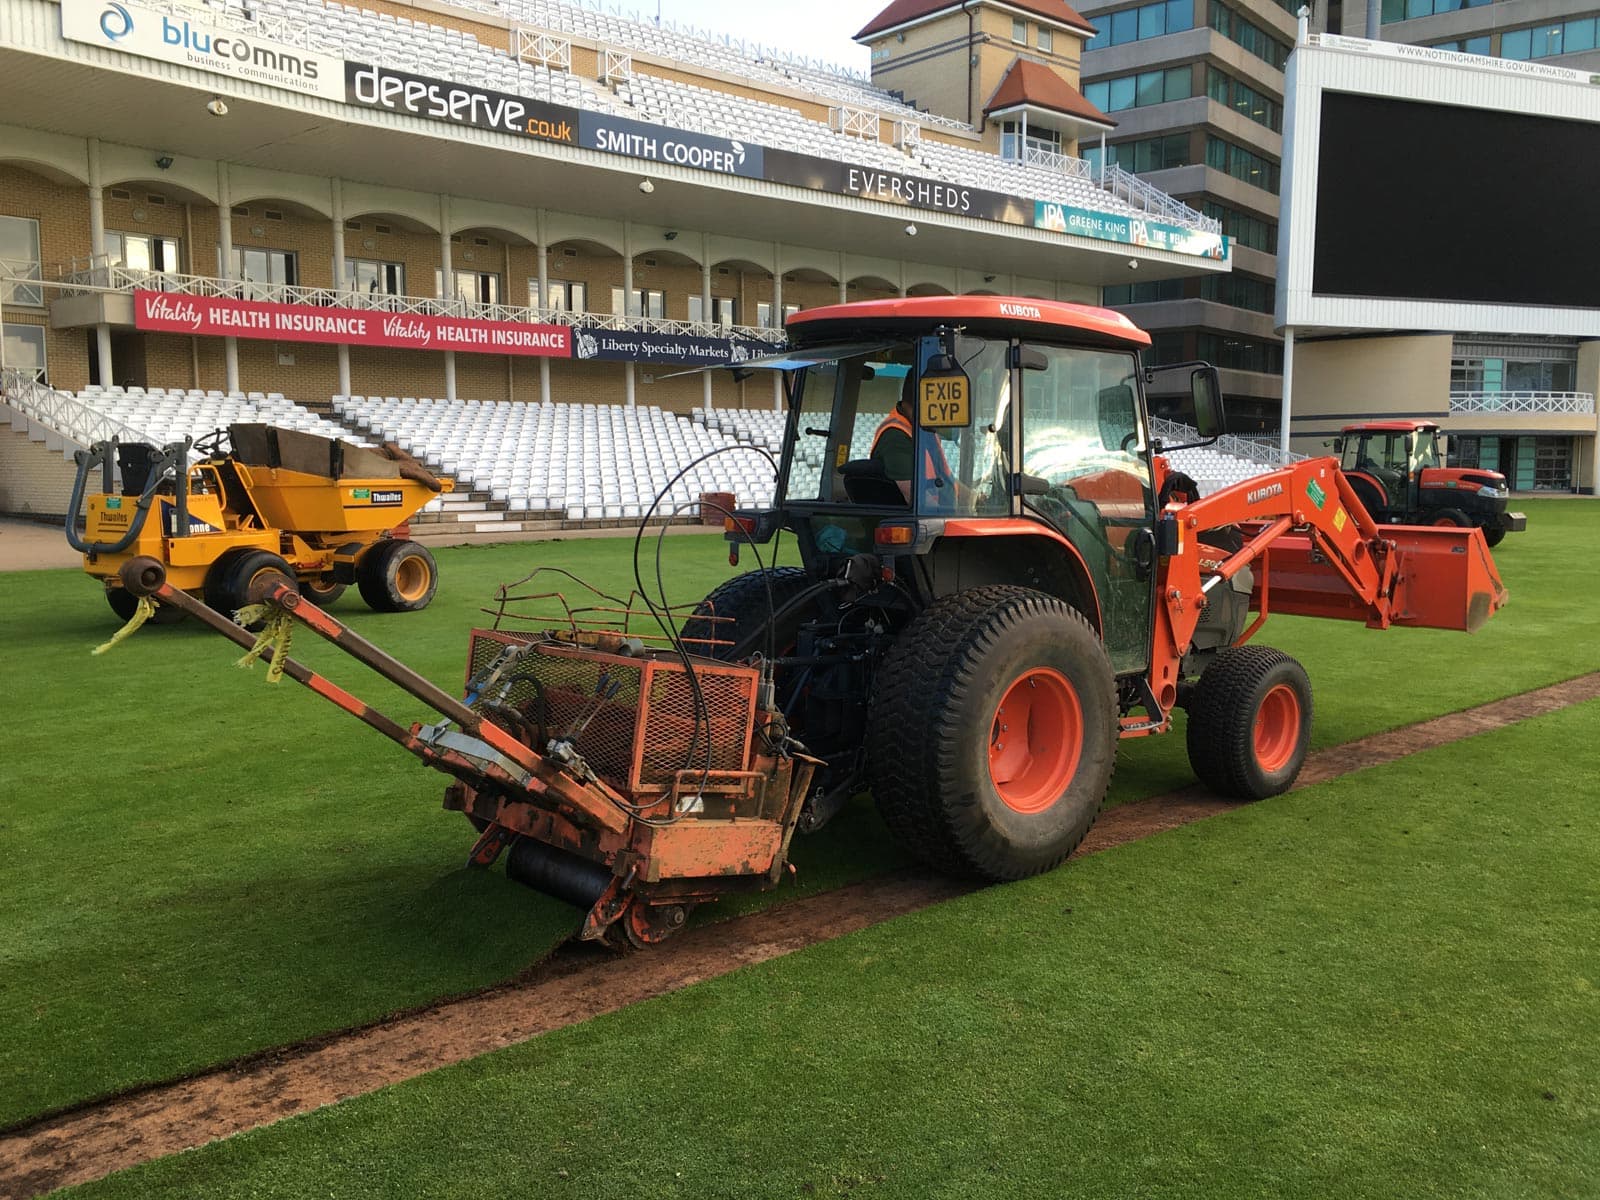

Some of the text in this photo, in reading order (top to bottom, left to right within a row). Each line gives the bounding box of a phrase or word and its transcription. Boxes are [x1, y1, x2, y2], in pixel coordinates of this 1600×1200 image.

[162, 16, 319, 79] blucomms
[186, 52, 320, 92] business communications
[596, 128, 736, 174] SMITH COOPER
[848, 168, 971, 212] EVERSHEDS
[1043, 204, 1066, 228] IPA
[1069, 215, 1103, 231] GREENE
[1105, 222, 1126, 235] KING
[1129, 220, 1149, 244] IPA
[145, 295, 565, 349] Vitality HEALTH INSURANCE Vitality HEALTH INSURANCE
[999, 303, 1041, 319] KUBOTA
[602, 338, 639, 356] Liberty
[641, 341, 687, 360] Specialty
[689, 344, 729, 358] Markets
[925, 382, 962, 400] FX16
[927, 404, 960, 421] CYP
[1247, 482, 1284, 505] KUBOTA
[100, 511, 127, 522] Thwaites
[189, 523, 210, 533] onne
